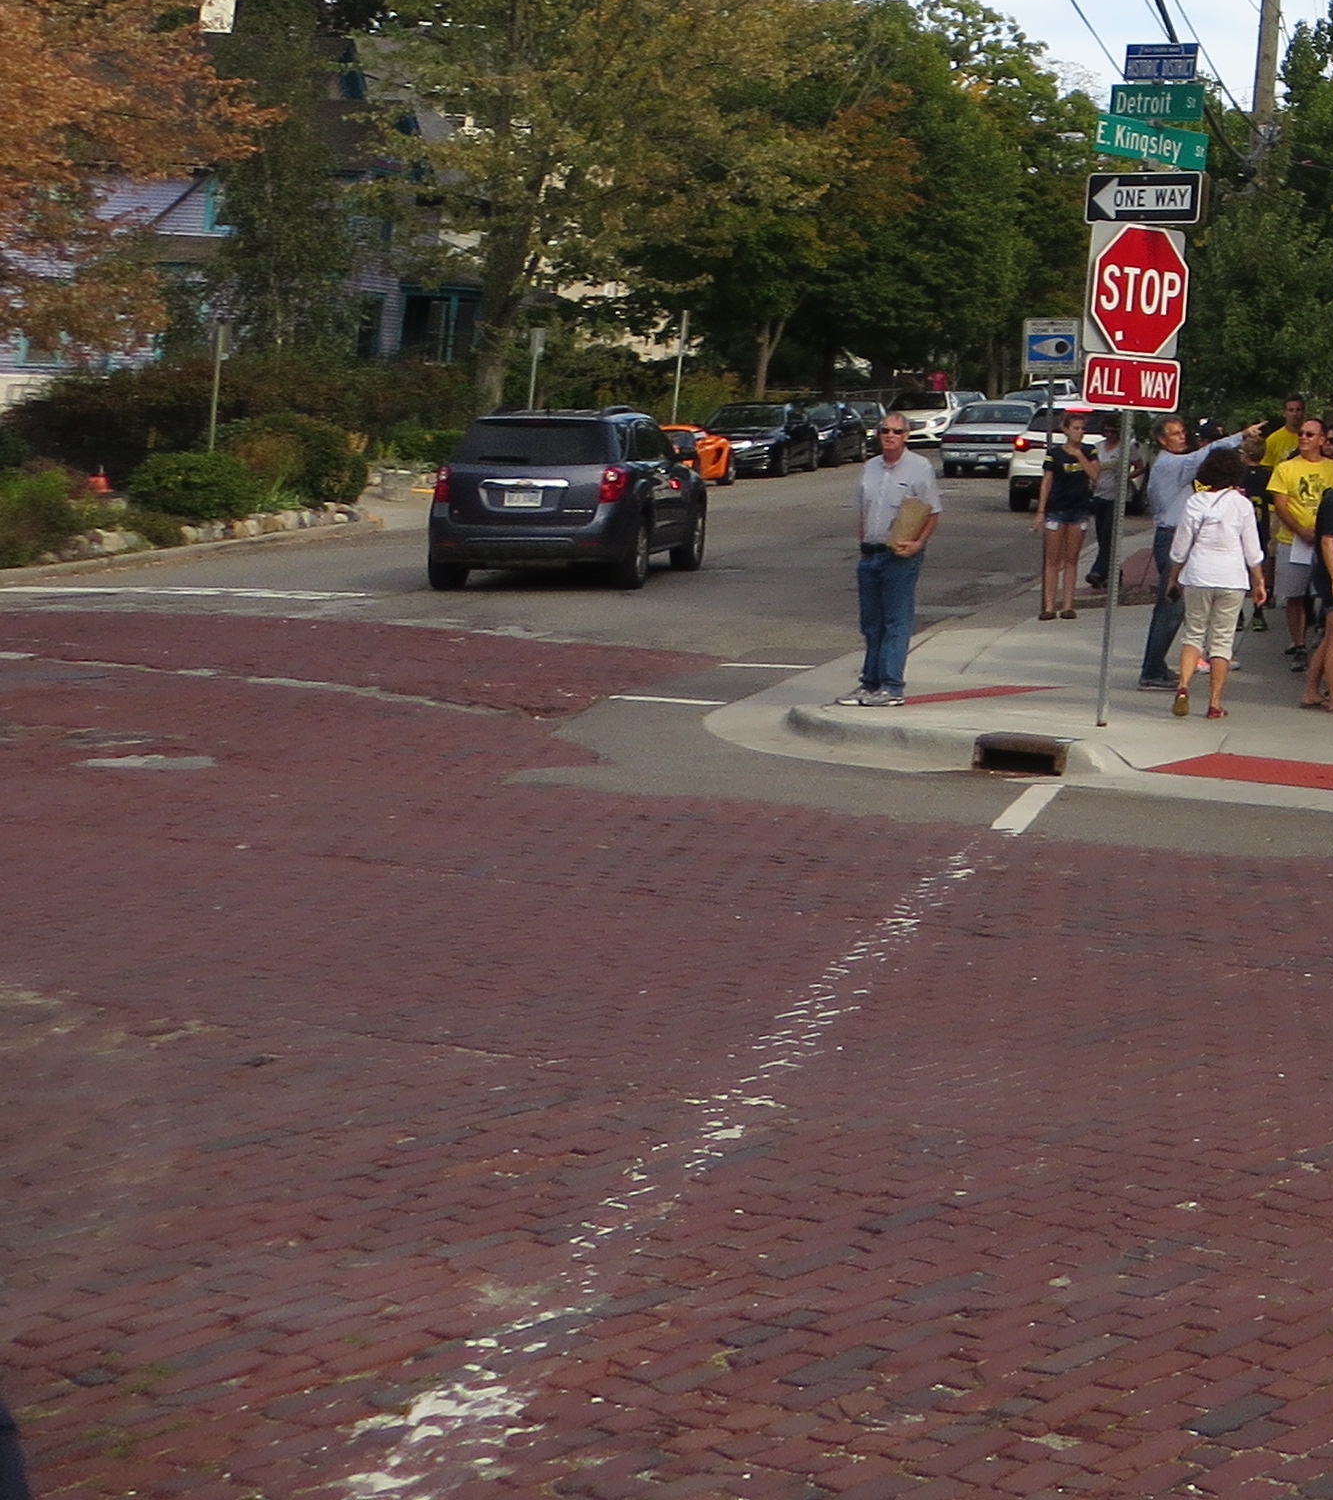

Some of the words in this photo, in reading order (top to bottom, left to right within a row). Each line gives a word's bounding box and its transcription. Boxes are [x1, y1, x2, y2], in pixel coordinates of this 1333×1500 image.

[1115, 91, 1172, 114] Detroit
[1186, 96, 1197, 109] St
[1096, 120, 1111, 146] E.
[1114, 124, 1182, 163] Kingsley
[1195, 145, 1206, 158] St
[1114, 189, 1147, 208] ONE
[1155, 188, 1190, 207] WAY
[1100, 264, 1182, 316] STOP
[1088, 367, 1126, 398] ALL
[1140, 371, 1176, 402] WAY
